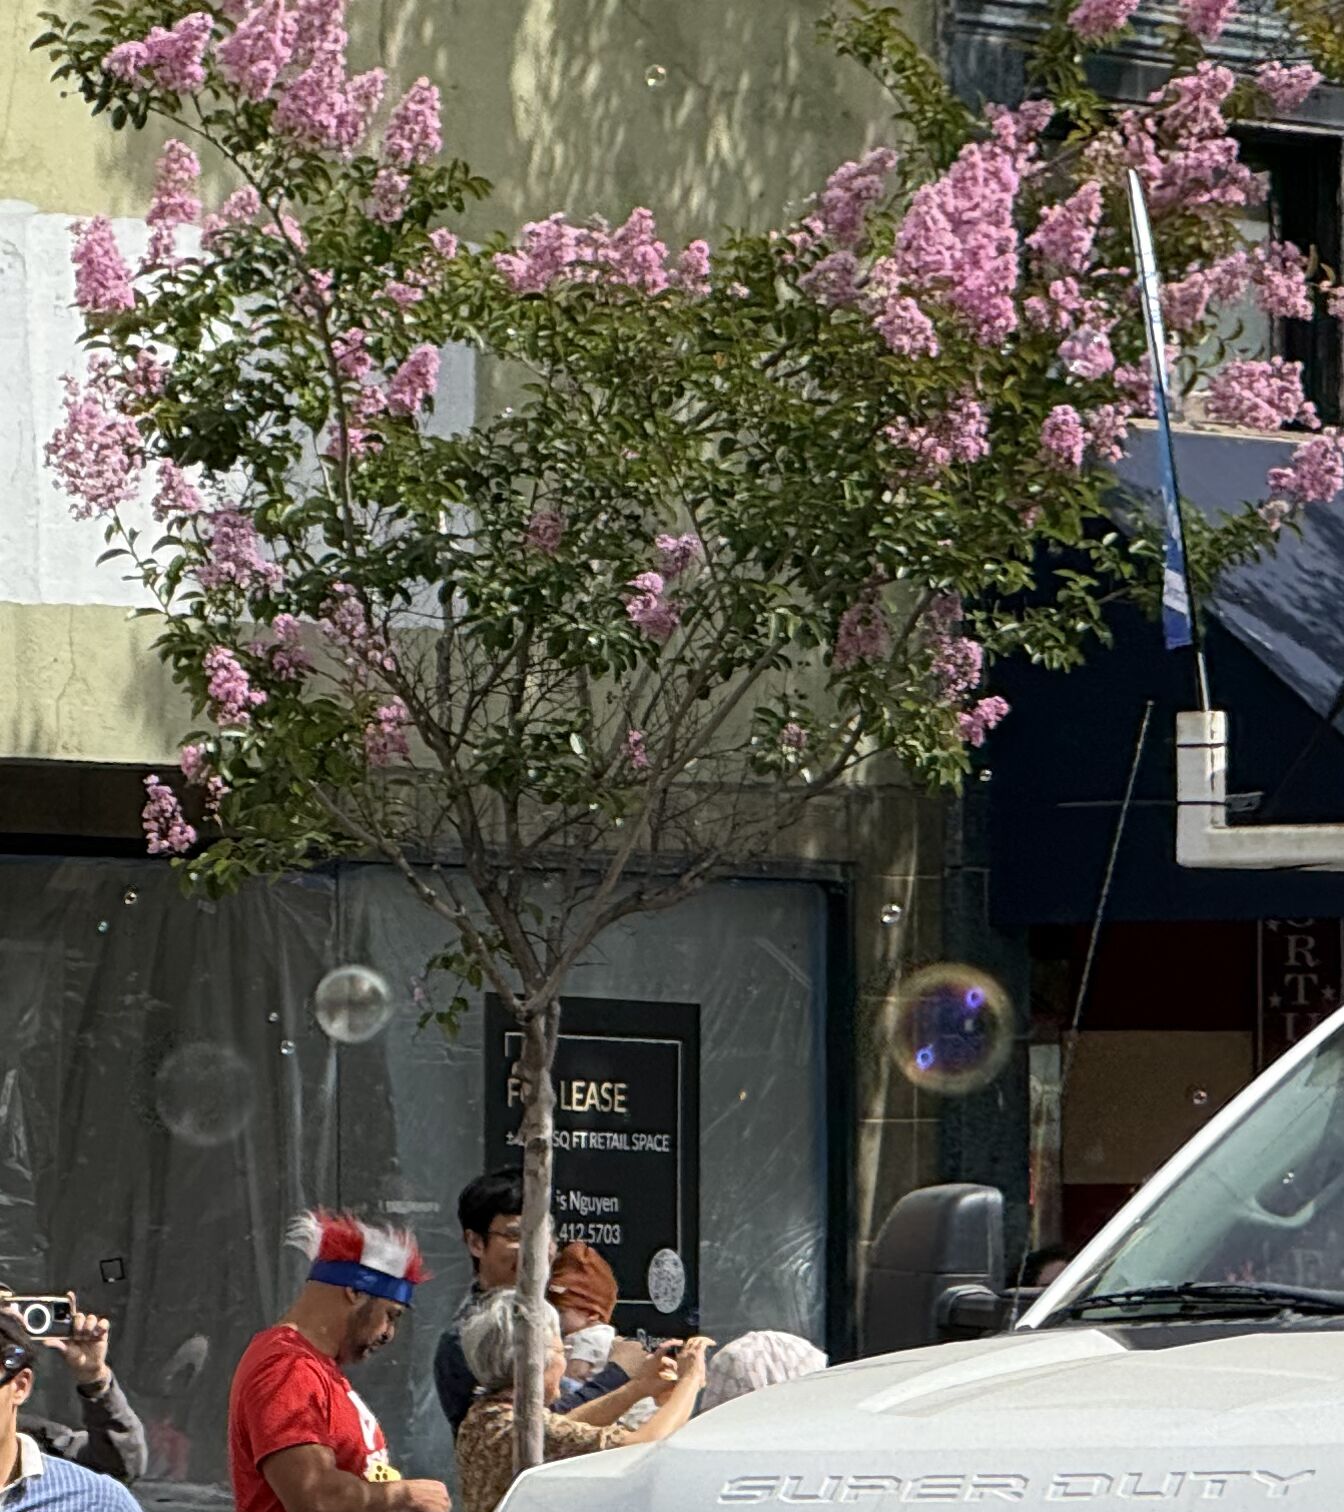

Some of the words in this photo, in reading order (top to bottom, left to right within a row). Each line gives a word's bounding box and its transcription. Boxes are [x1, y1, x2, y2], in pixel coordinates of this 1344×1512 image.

[560, 1080, 628, 1113] LEASE
[553, 1131, 569, 1150] SQ
[573, 1131, 588, 1149] FT
[589, 1132, 630, 1151] RETAIL
[631, 1133, 670, 1152] SPACE
[569, 1190, 619, 1216] Nguyen
[720, 1473, 1030, 1504] SUPER
[1046, 1469, 1317, 1502] DUTY
